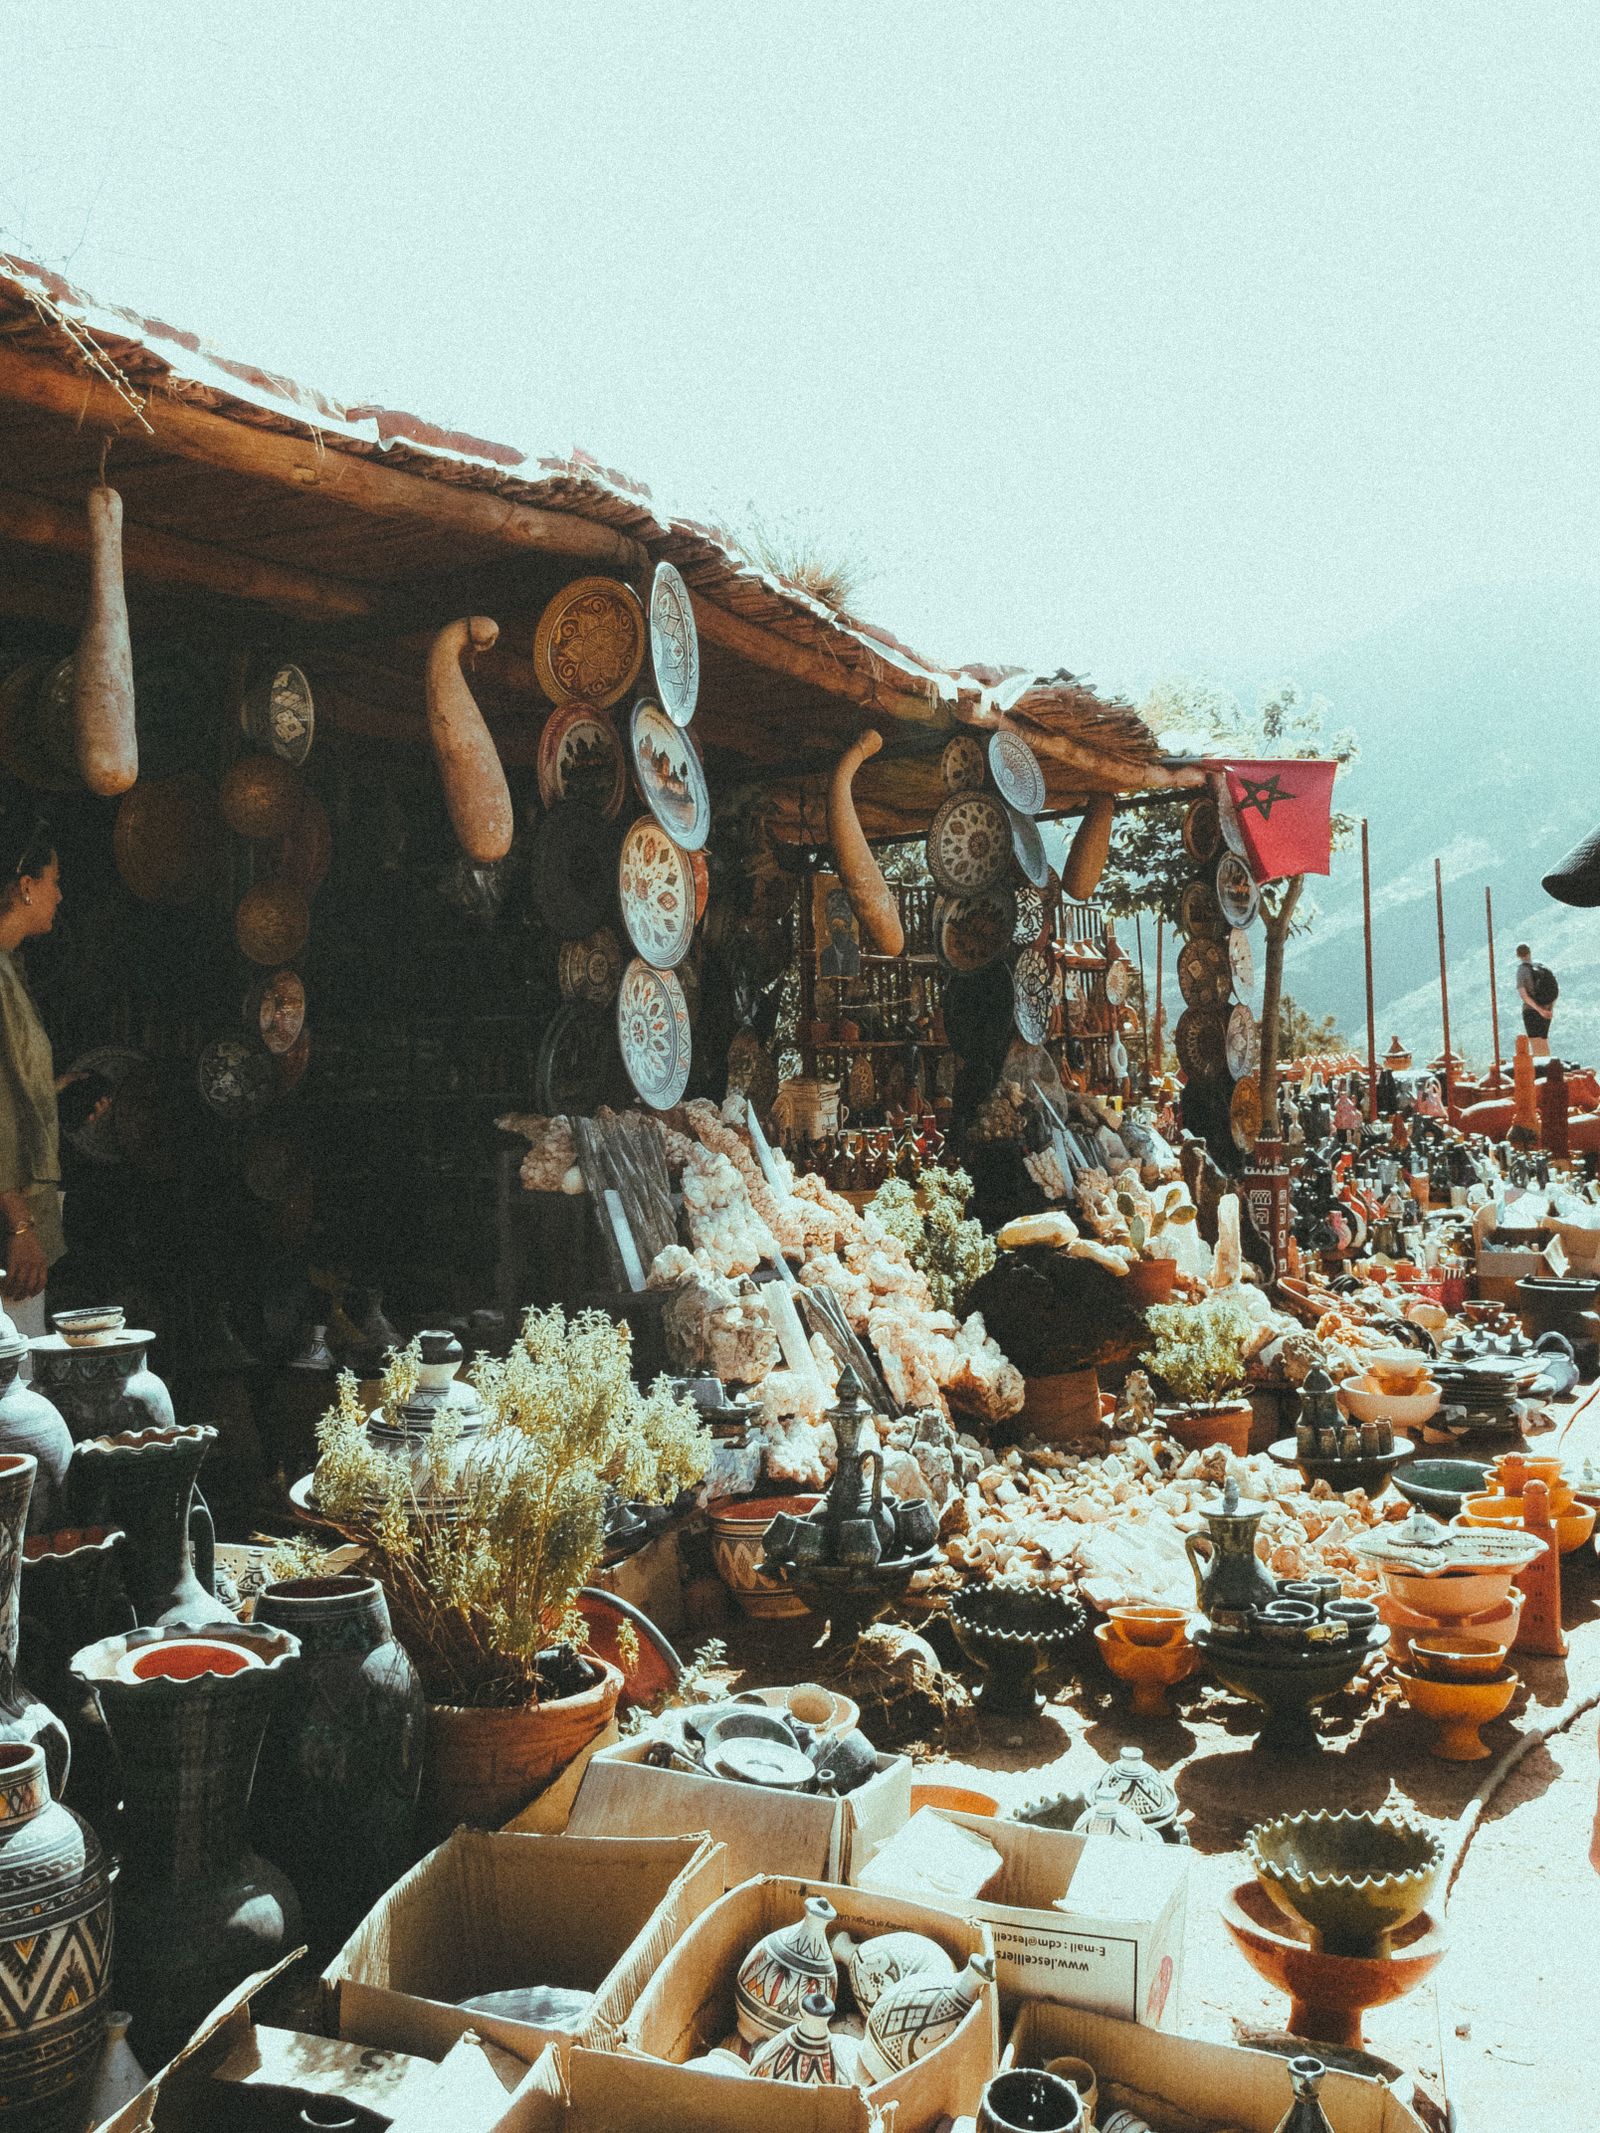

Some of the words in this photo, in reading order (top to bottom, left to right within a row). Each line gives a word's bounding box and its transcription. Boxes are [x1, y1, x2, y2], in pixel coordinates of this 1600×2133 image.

[992, 1931, 1062, 1949] cdm@lescell
[1070, 1943, 1106, 1956] E-mail
[996, 1951, 1089, 1971] www.lescelliers
